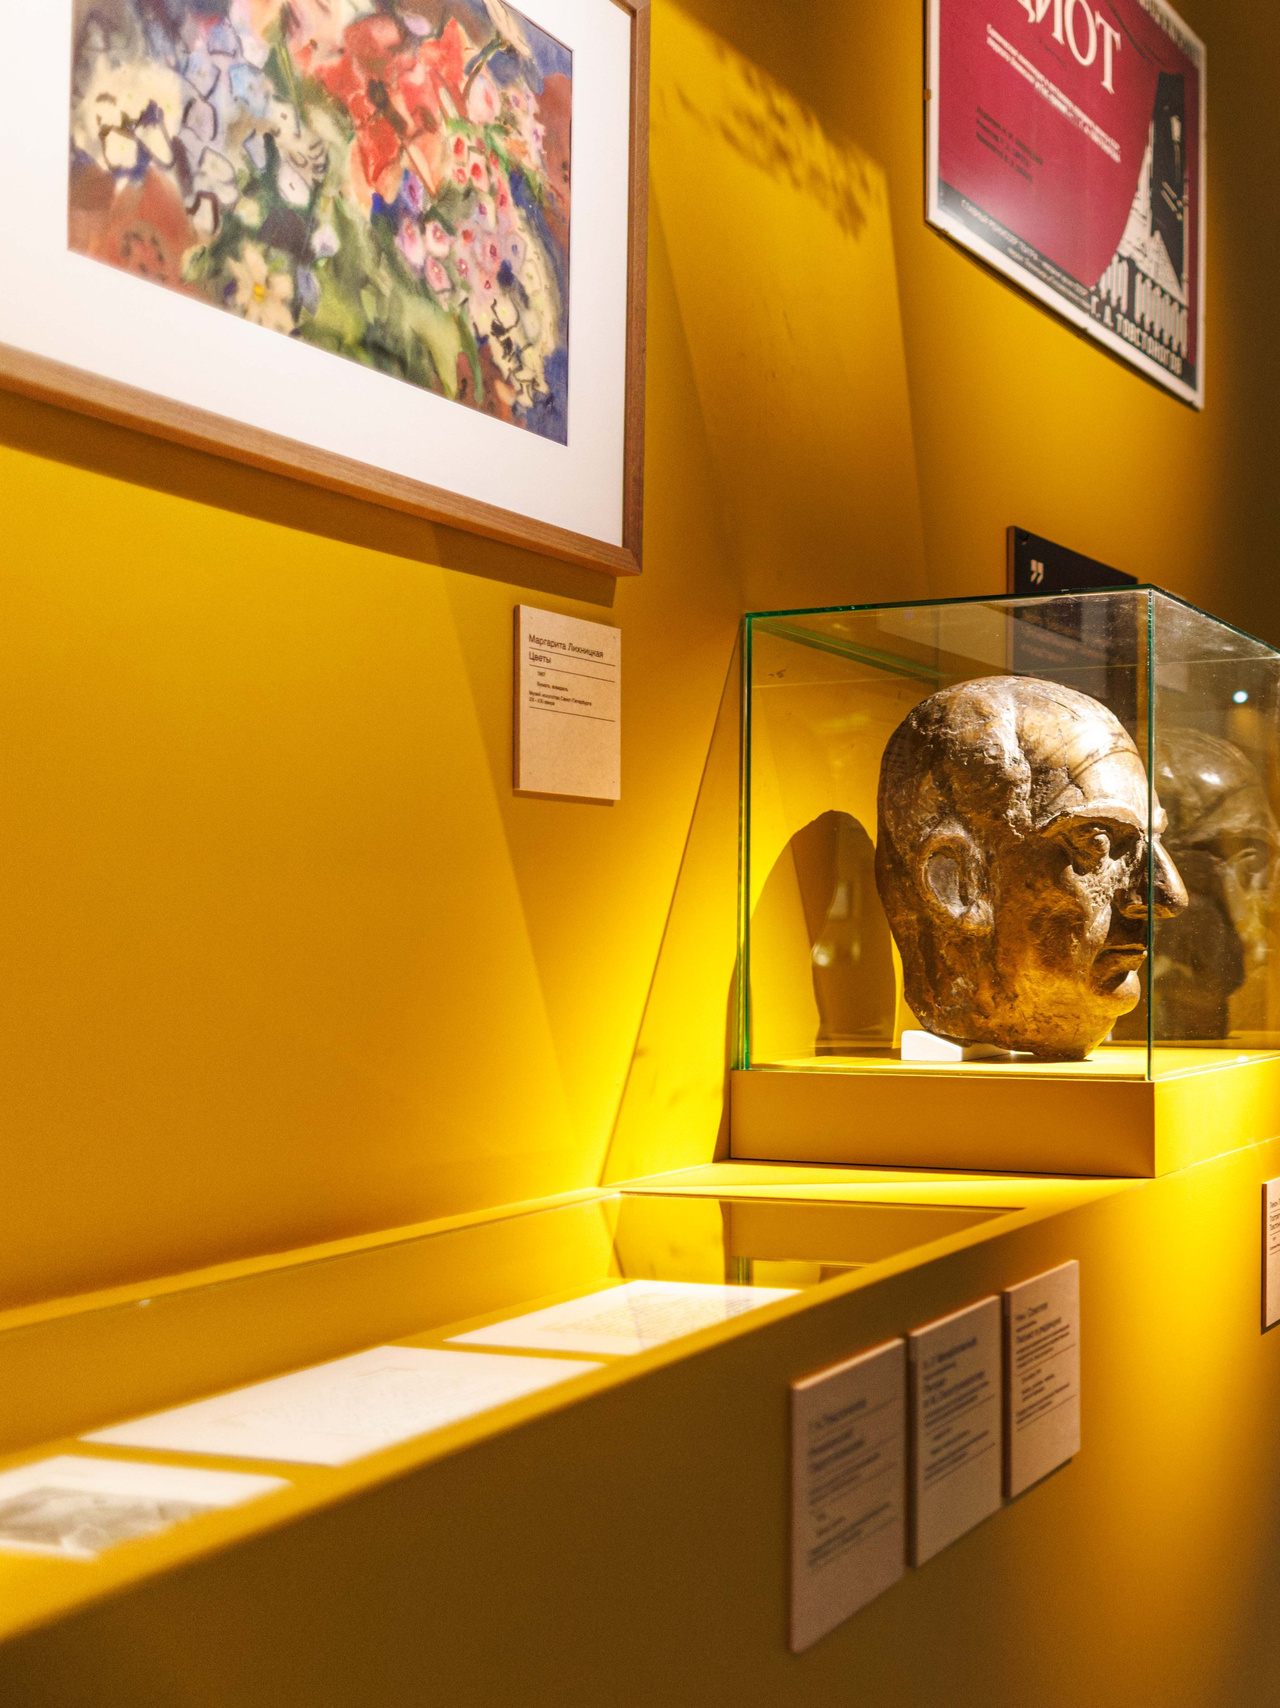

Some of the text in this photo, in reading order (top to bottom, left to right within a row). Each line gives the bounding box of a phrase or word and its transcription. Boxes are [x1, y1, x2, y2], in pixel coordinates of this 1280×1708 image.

[529, 634, 604, 658] Маргарита Лихницкая
[528, 651, 552, 664] Цветы
